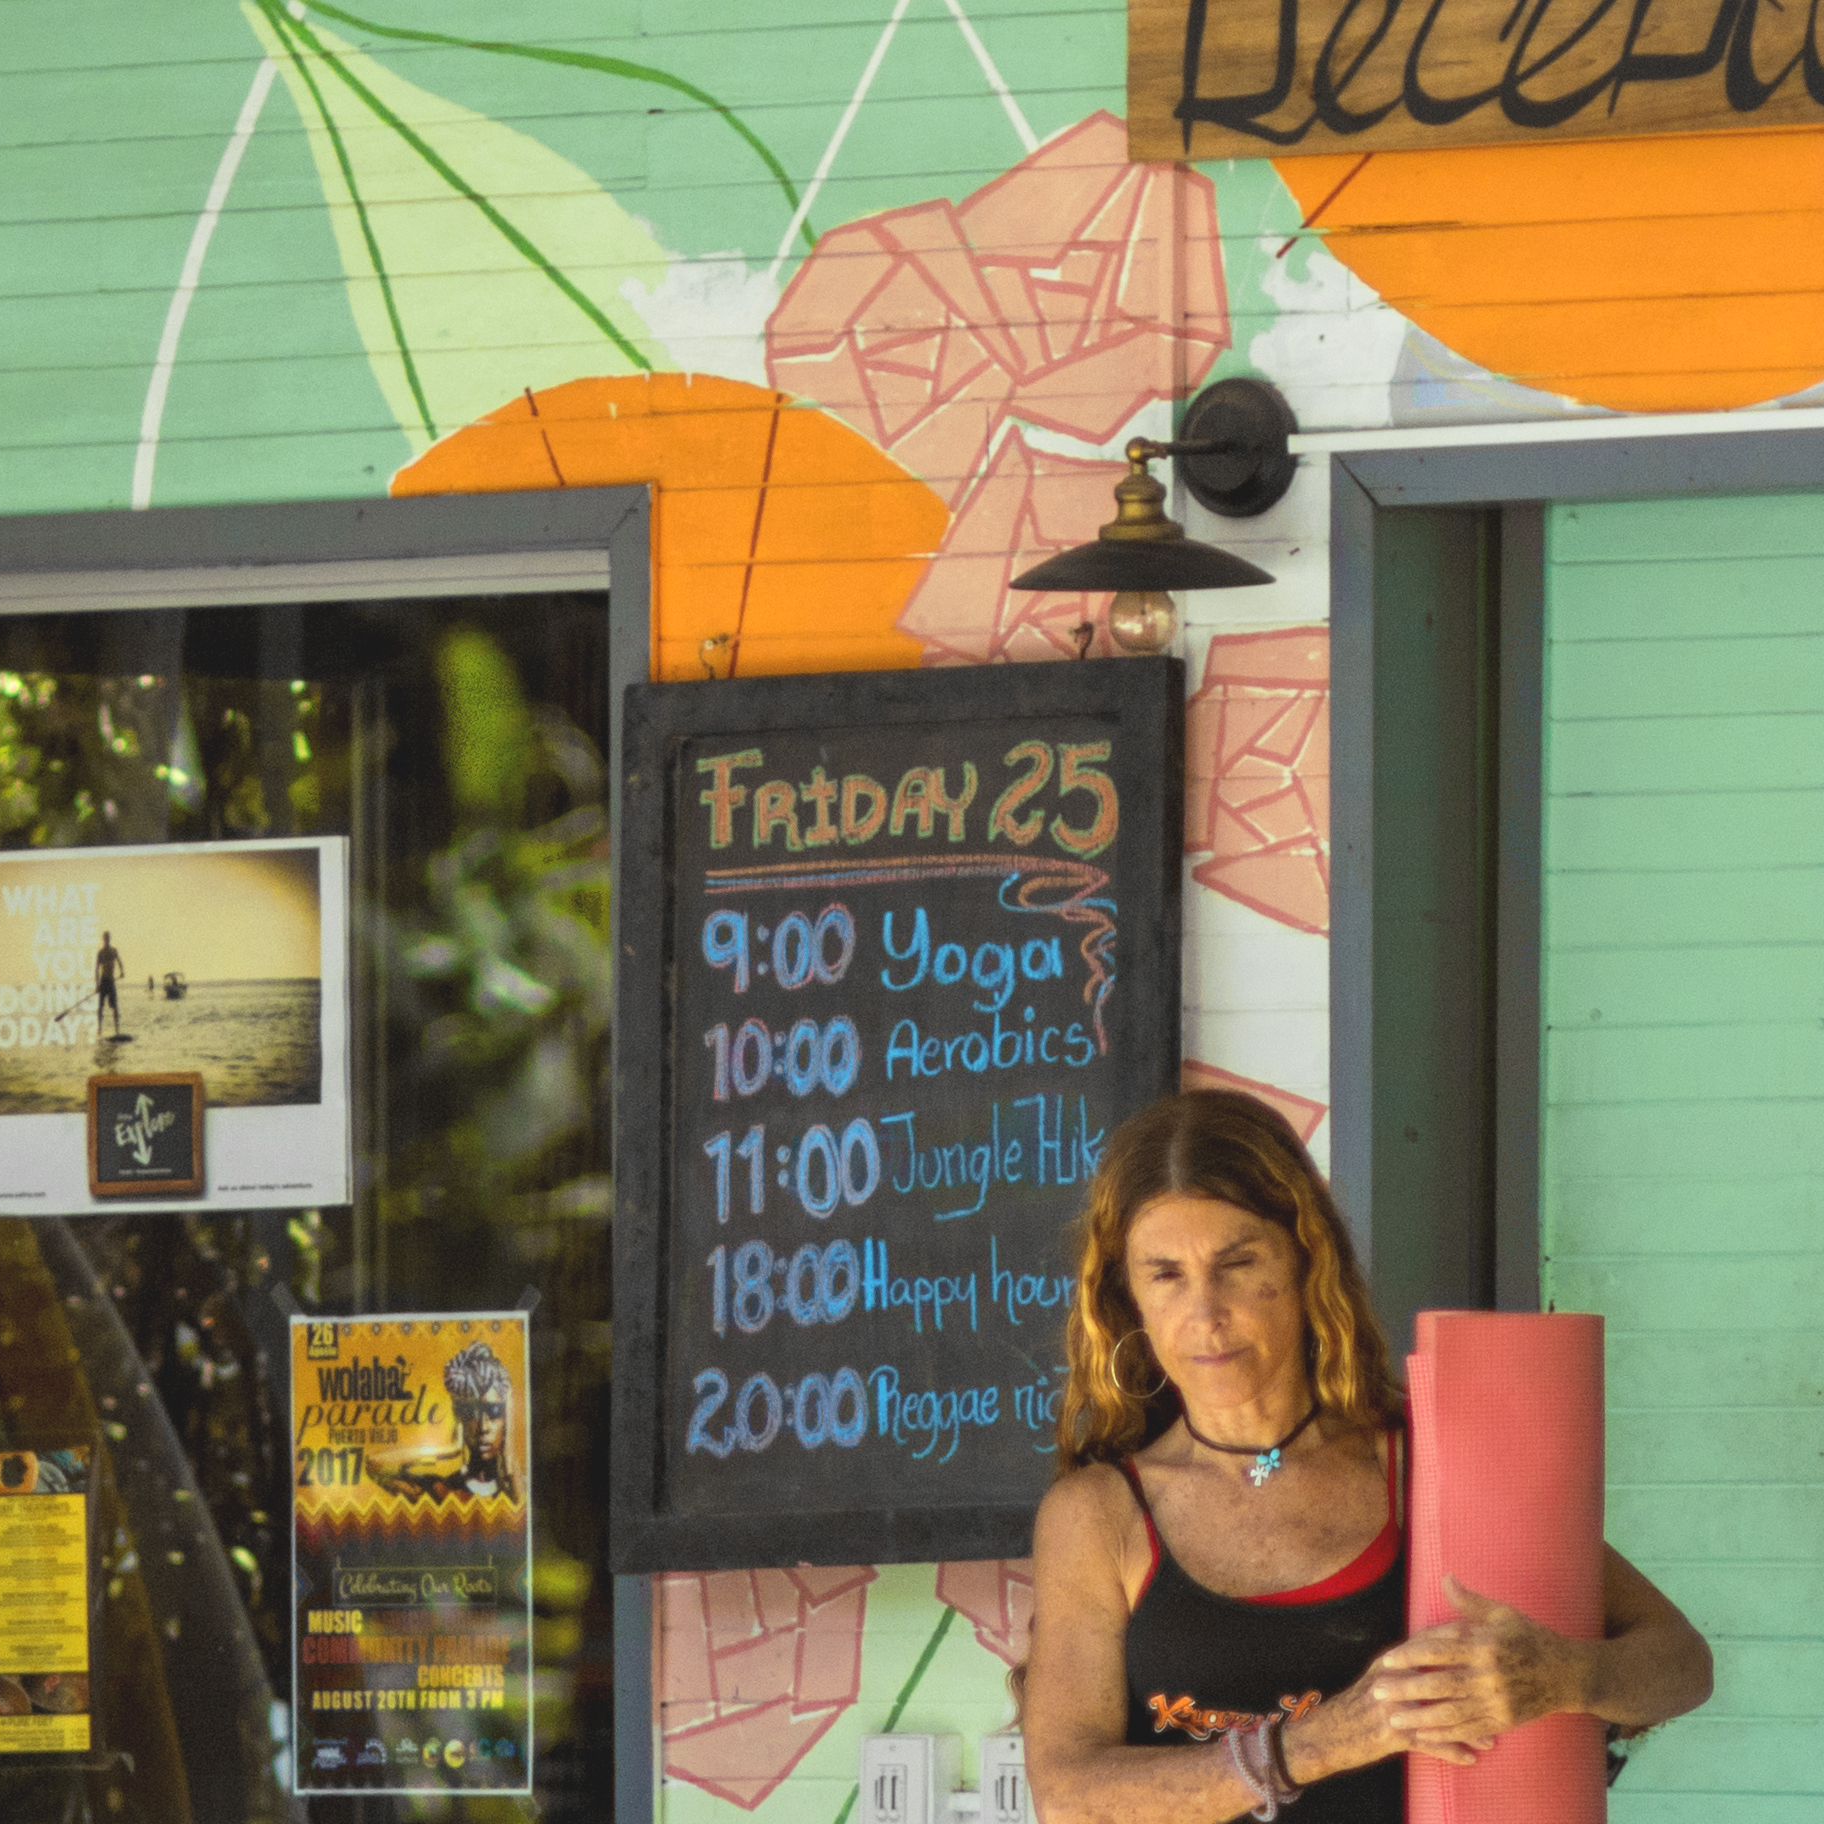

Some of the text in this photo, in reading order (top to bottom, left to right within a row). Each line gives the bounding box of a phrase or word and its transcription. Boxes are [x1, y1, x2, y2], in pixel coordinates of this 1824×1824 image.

[696, 739, 1119, 859] FRIDAY 25
[1, 882, 99, 915] WHAT
[32, 916, 98, 947] ARE
[31, 948, 96, 980] YOU
[701, 902, 1064, 1014] 9:00 Yoga
[704, 1006, 1095, 1100] 10:00 Aerobics
[703, 1116, 880, 1224] 11:00
[880, 1102, 1022, 1222] Jungle
[706, 1238, 859, 1337] 18:00
[863, 1236, 976, 1333] Happy
[296, 1384, 446, 1446] parade
[686, 1367, 869, 1459] 20:00
[868, 1364, 999, 1464] Reggae
[297, 1447, 364, 1488] 2017
[307, 1610, 363, 1634] MUSIC
[312, 1690, 505, 1710] AUGUST 26TH FROM 3 PM
[417, 1664, 505, 1688] CONCERTS
